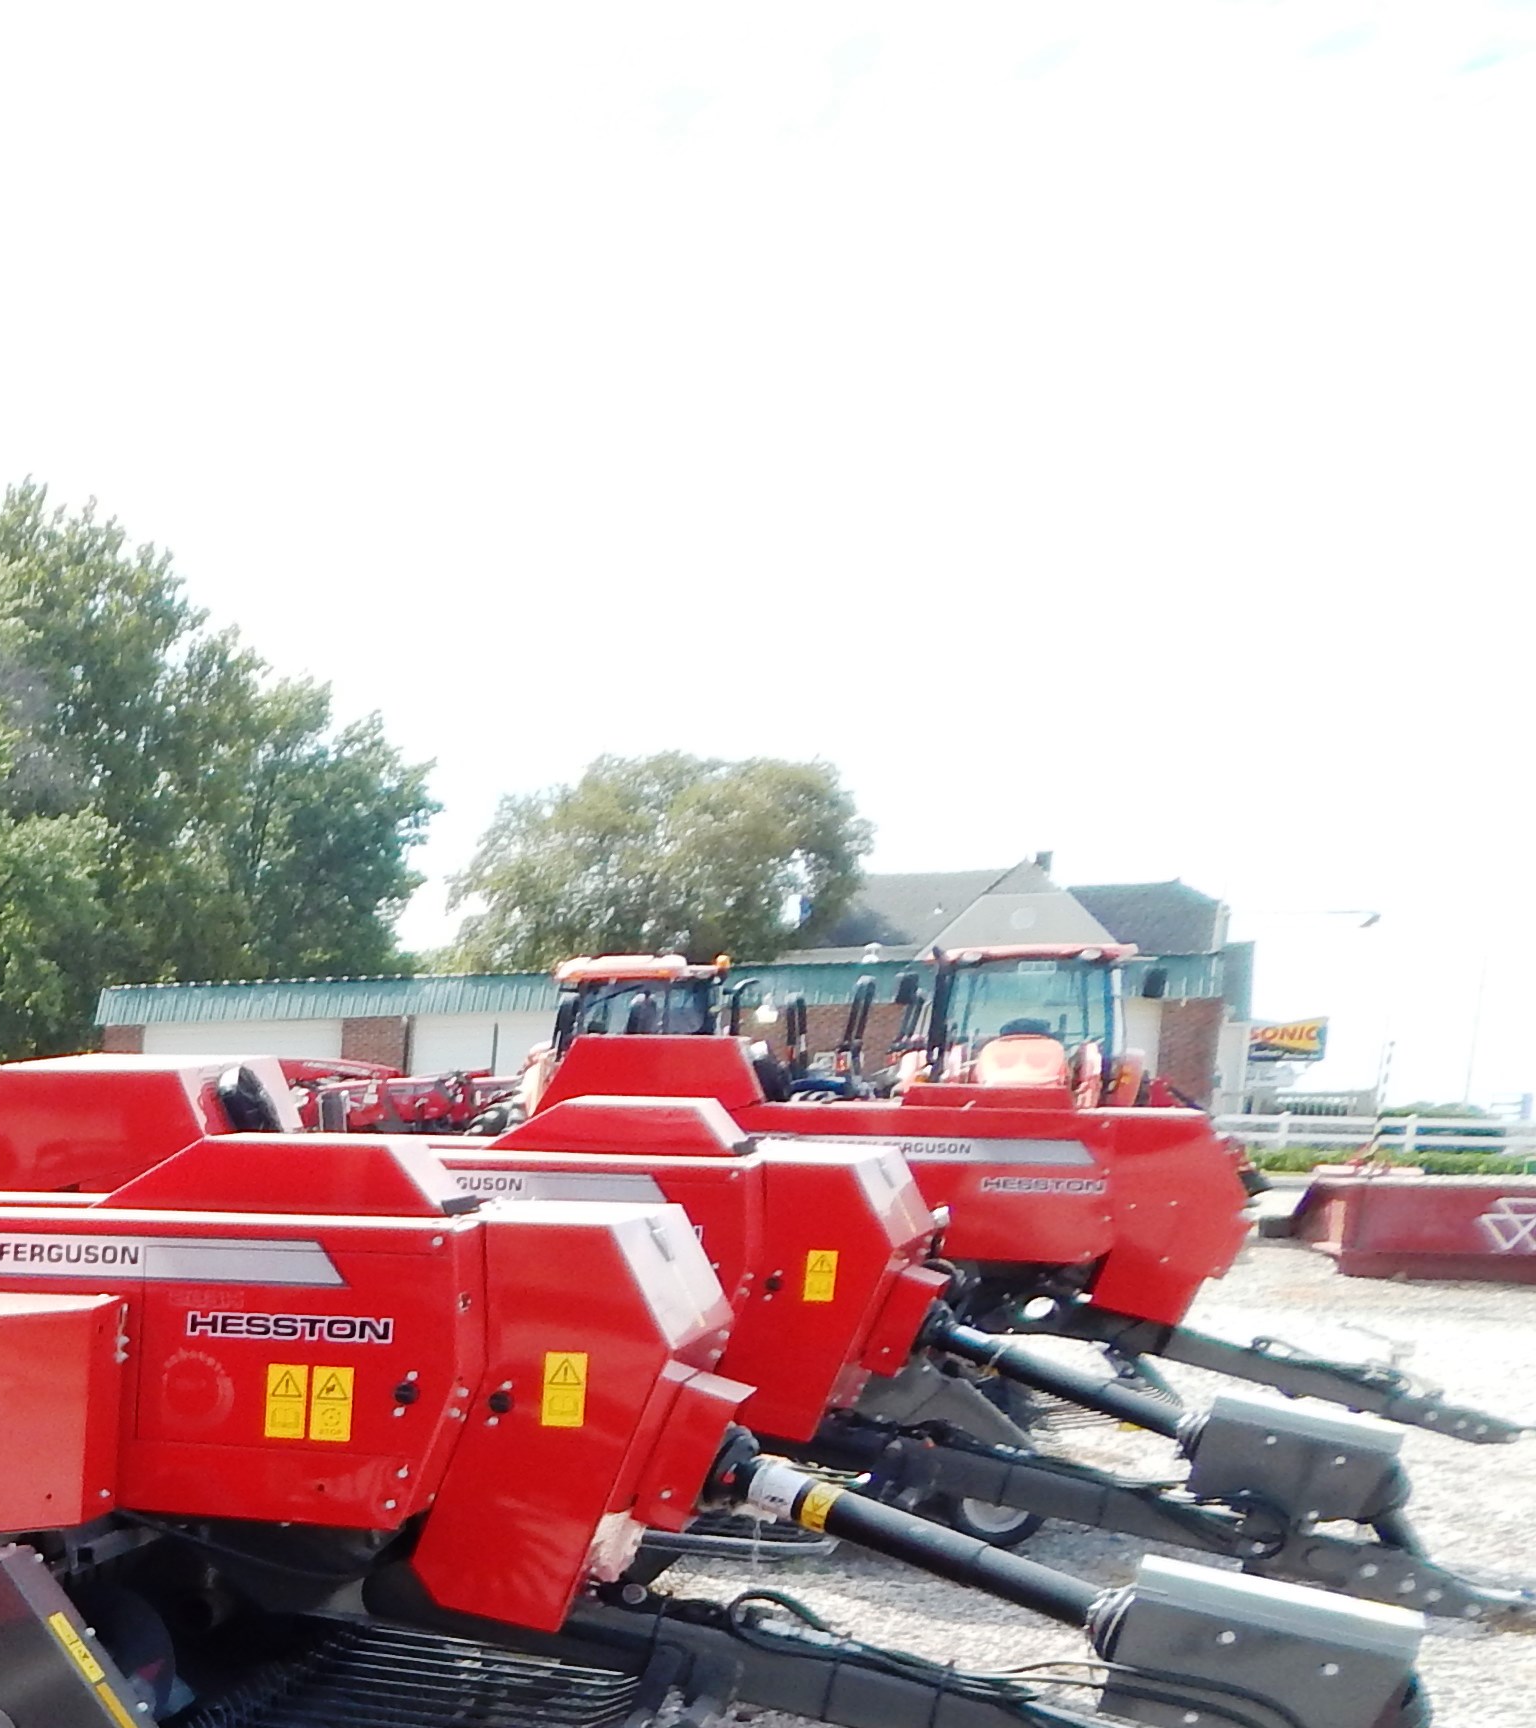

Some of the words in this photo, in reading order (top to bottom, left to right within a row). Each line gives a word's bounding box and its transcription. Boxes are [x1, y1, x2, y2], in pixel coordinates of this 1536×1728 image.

[1249, 1026, 1318, 1041] SONIC
[455, 1175, 523, 1192] GUSON
[981, 1177, 1105, 1193] HESSTON
[188, 1312, 393, 1343] HESSTON
